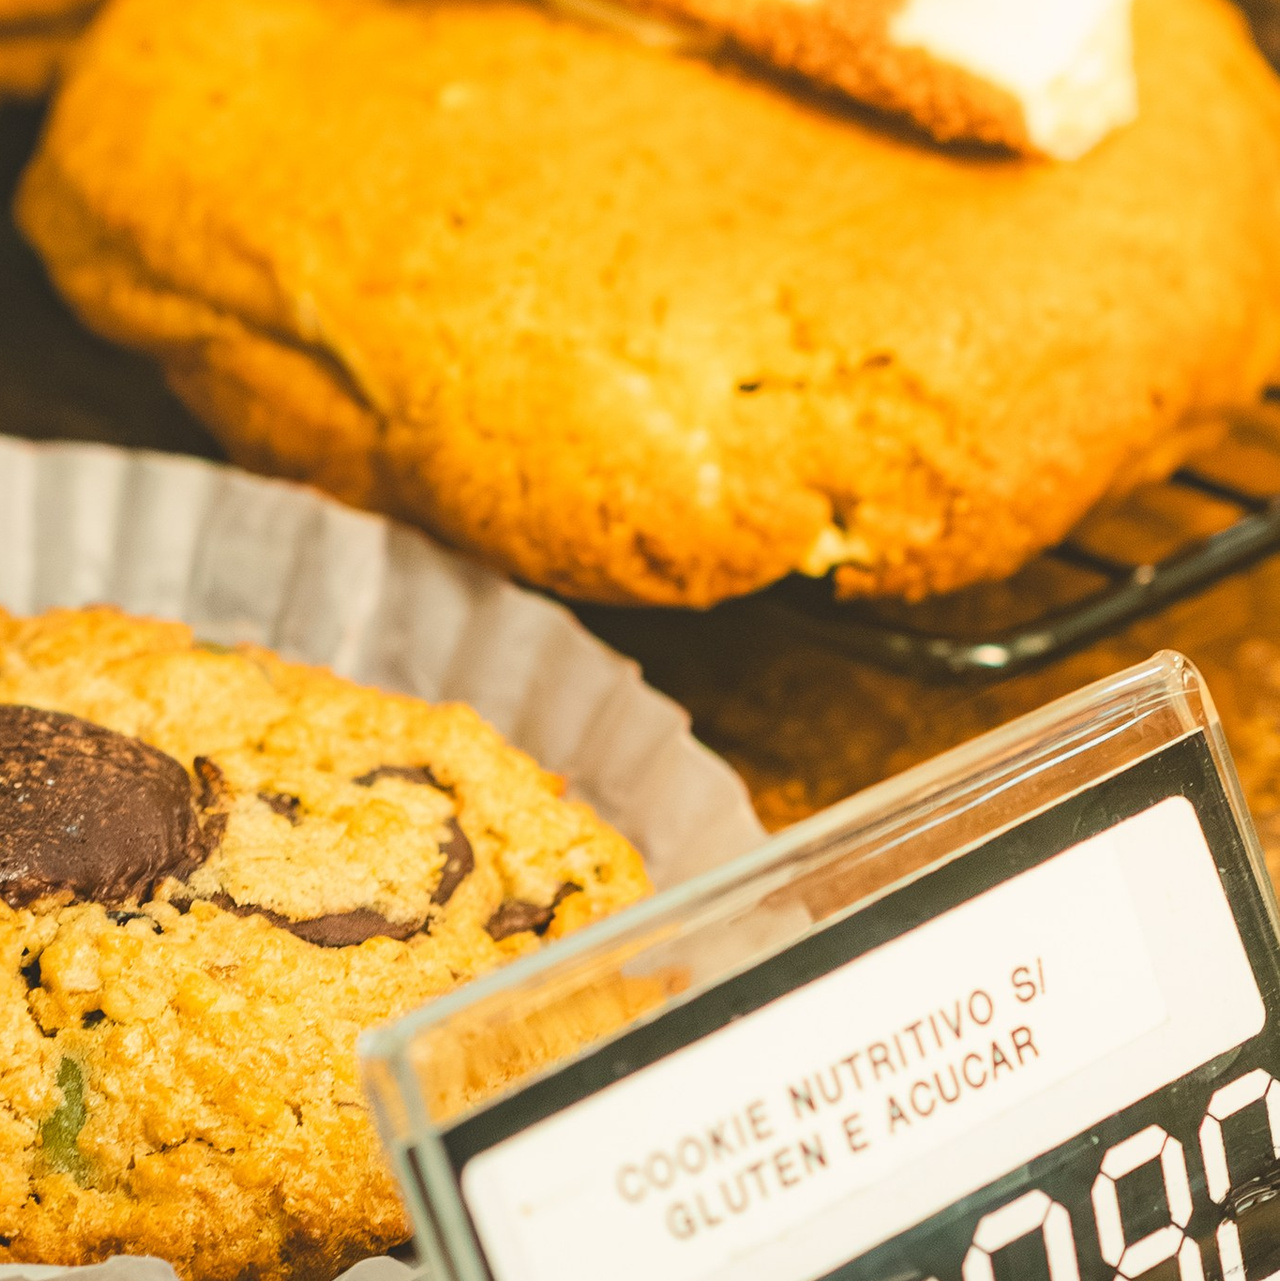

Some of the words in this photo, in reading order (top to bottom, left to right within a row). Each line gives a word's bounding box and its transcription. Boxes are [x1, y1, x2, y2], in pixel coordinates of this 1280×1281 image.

[616, 1099, 774, 1203] COOKIE
[787, 990, 994, 1119] NUTRITIVO
[665, 1133, 828, 1240] GLUTEN
[842, 1113, 870, 1153] E
[886, 1026, 1039, 1133] ACUCAR
